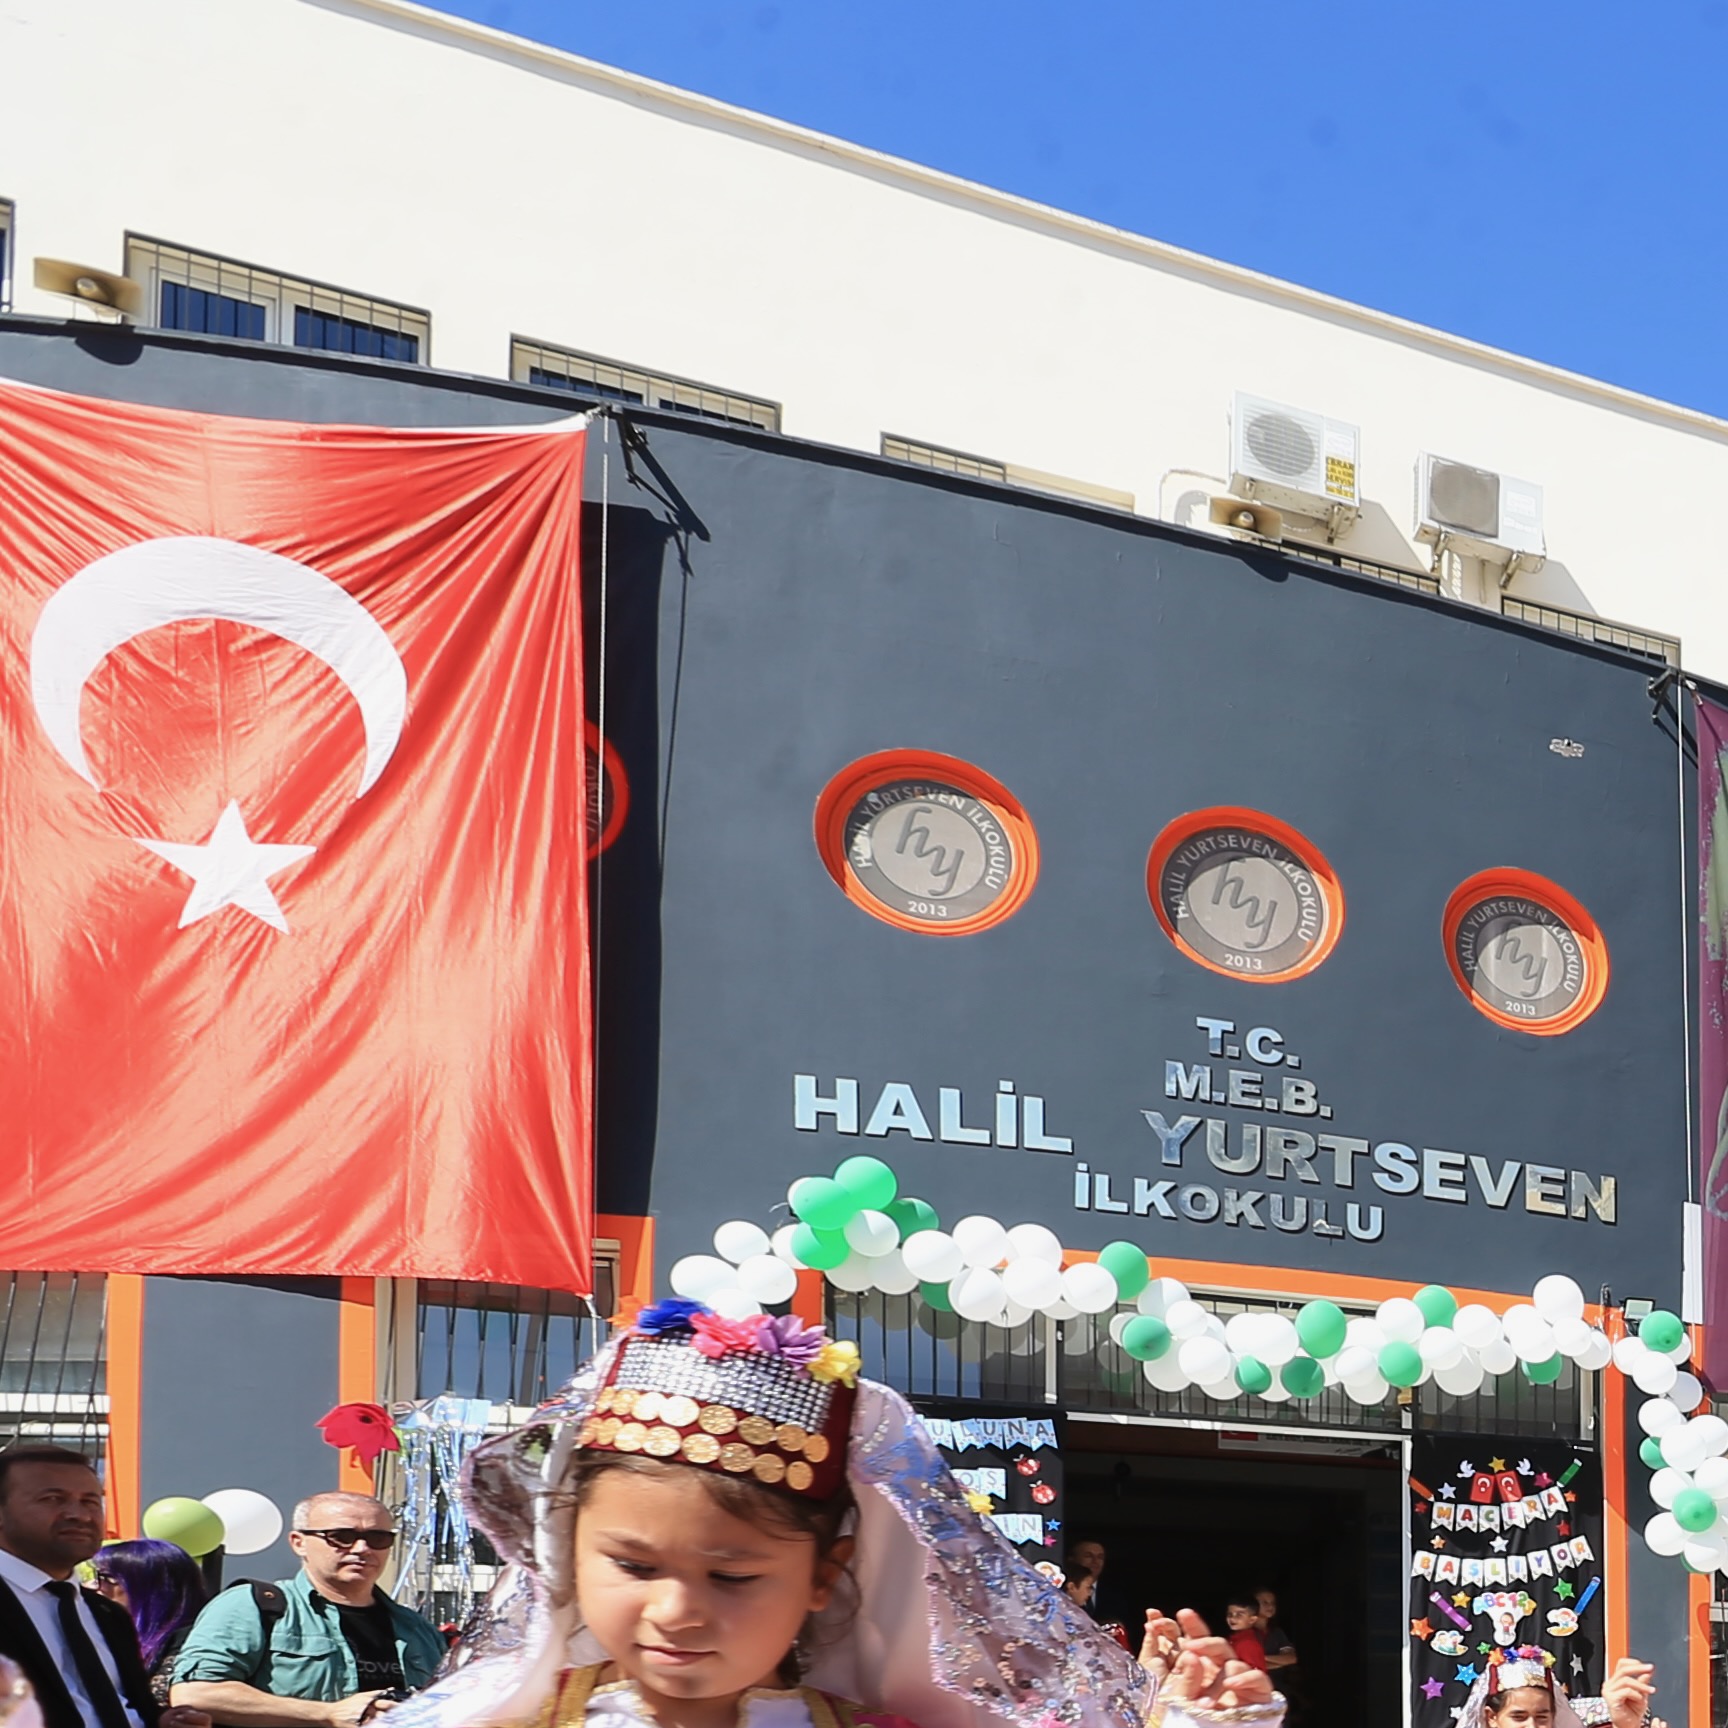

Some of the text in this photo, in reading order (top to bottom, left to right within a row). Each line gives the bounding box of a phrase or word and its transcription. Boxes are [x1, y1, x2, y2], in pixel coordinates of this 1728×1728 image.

[967, 805, 1008, 890] İLKOKULU
[908, 901, 948, 917] 2013
[1177, 834, 1278, 868] YURTSEVEN
[1279, 856, 1318, 942] İLKOKULU
[1224, 953, 1263, 970] 2013
[1459, 901, 1580, 994] HALİL YURTSEVEN İLKOKULU
[1505, 1000, 1536, 1016] 2013
[1195, 1016, 1303, 1068] T.C.
[1164, 1059, 1333, 1119] M.E.B.
[793, 1074, 1618, 1226] HALİL YURTSEVEN
[1074, 1161, 1386, 1243] İLKOKULU
[1436, 1492, 1560, 1521] MACERA
